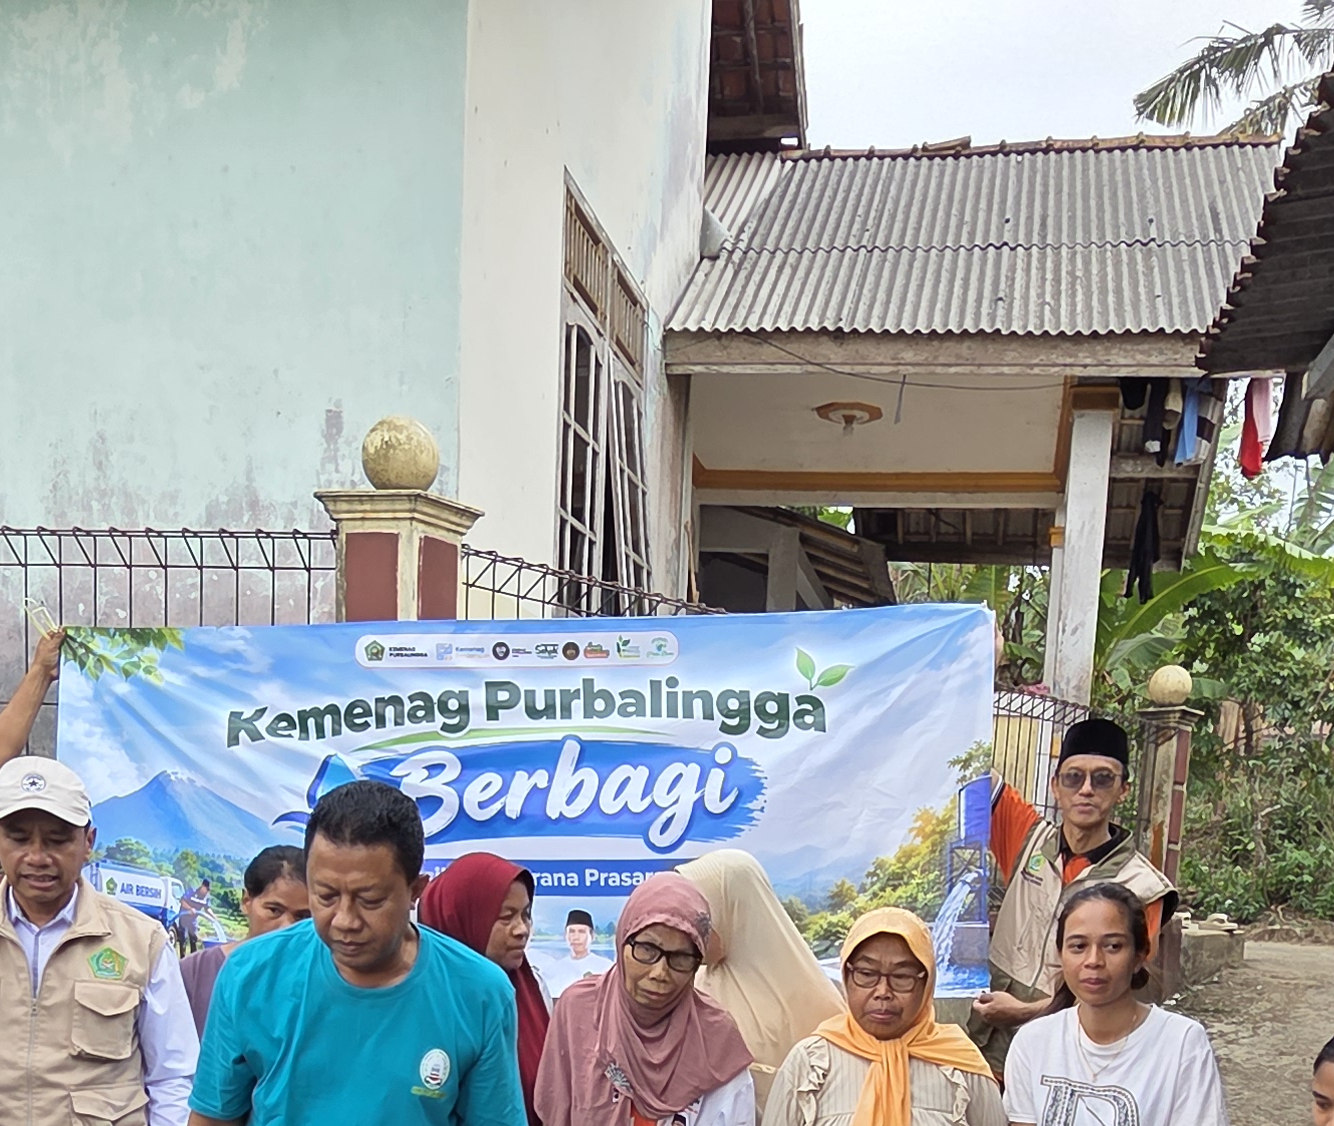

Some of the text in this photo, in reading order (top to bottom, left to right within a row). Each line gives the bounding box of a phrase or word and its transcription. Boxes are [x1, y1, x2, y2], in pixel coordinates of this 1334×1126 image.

[227, 676, 826, 748] Kemenag Purbalingga
[389, 738, 739, 848] Berbagi
[120, 882, 162, 899] AIR BERSIH
[534, 869, 667, 887] rana Prasar
